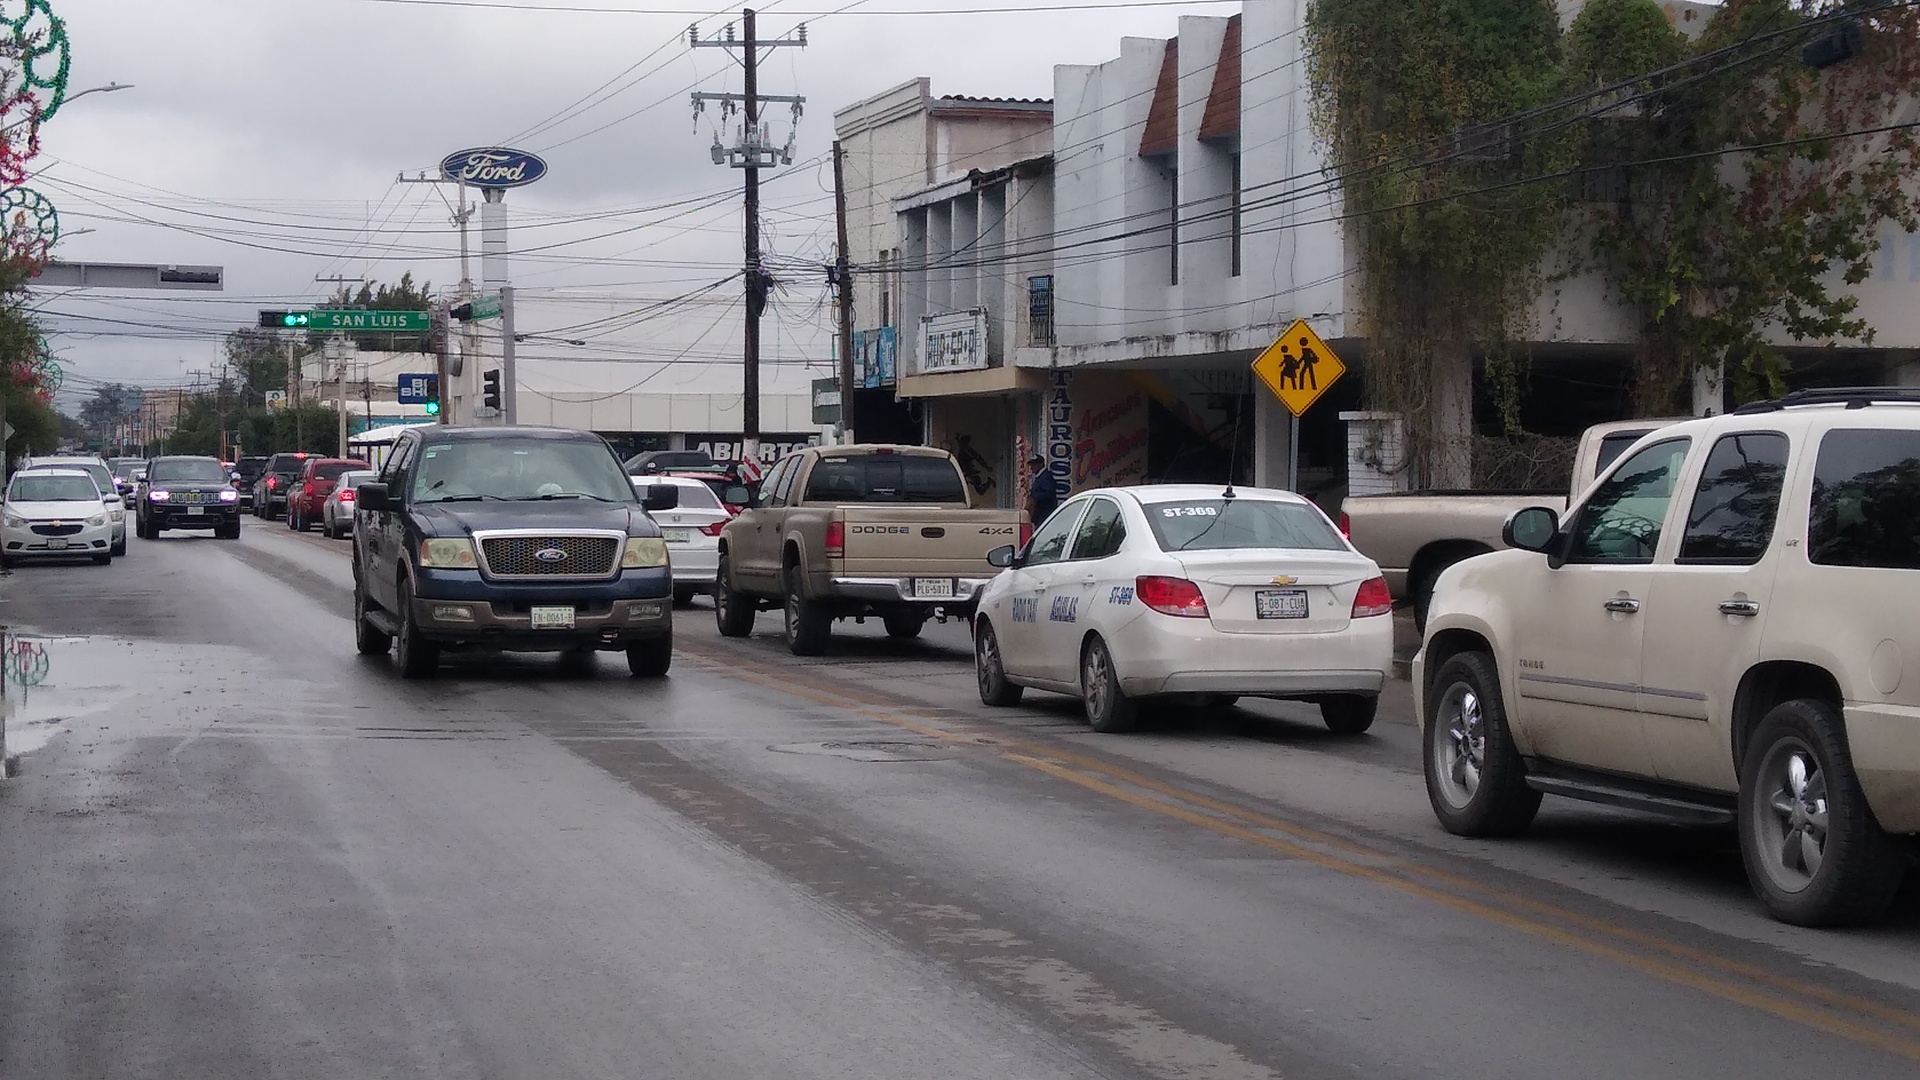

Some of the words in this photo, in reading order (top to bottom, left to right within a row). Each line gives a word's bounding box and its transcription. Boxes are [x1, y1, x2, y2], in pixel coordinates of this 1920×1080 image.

[463, 153, 527, 180] Ford
[332, 315, 365, 326] SAN
[371, 315, 407, 327] LUIS
[697, 442, 810, 461] ABIRTO
[852, 525, 910, 534] DODGE
